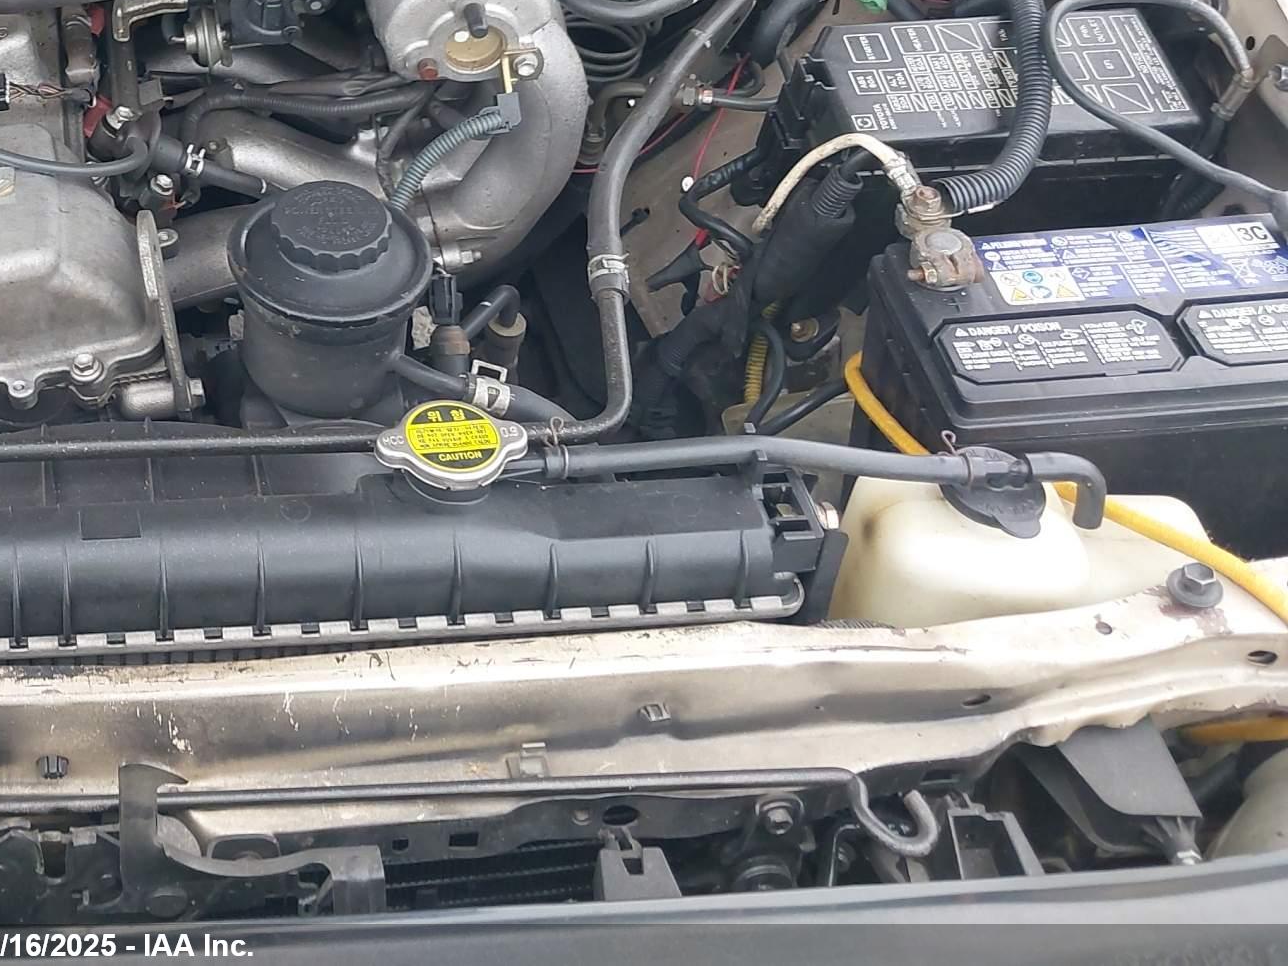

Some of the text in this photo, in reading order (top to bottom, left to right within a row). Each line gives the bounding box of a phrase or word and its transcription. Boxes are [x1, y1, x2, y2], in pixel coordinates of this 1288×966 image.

[906, 28, 924, 52] HEATER
[872, 103, 890, 130] TOYOTA
[1236, 225, 1269, 242] 3C
[1211, 307, 1257, 318] DANGER
[967, 324, 1012, 336] DANGER
[1019, 321, 1062, 333] POISON
[438, 450, 483, 462] CAUTION
